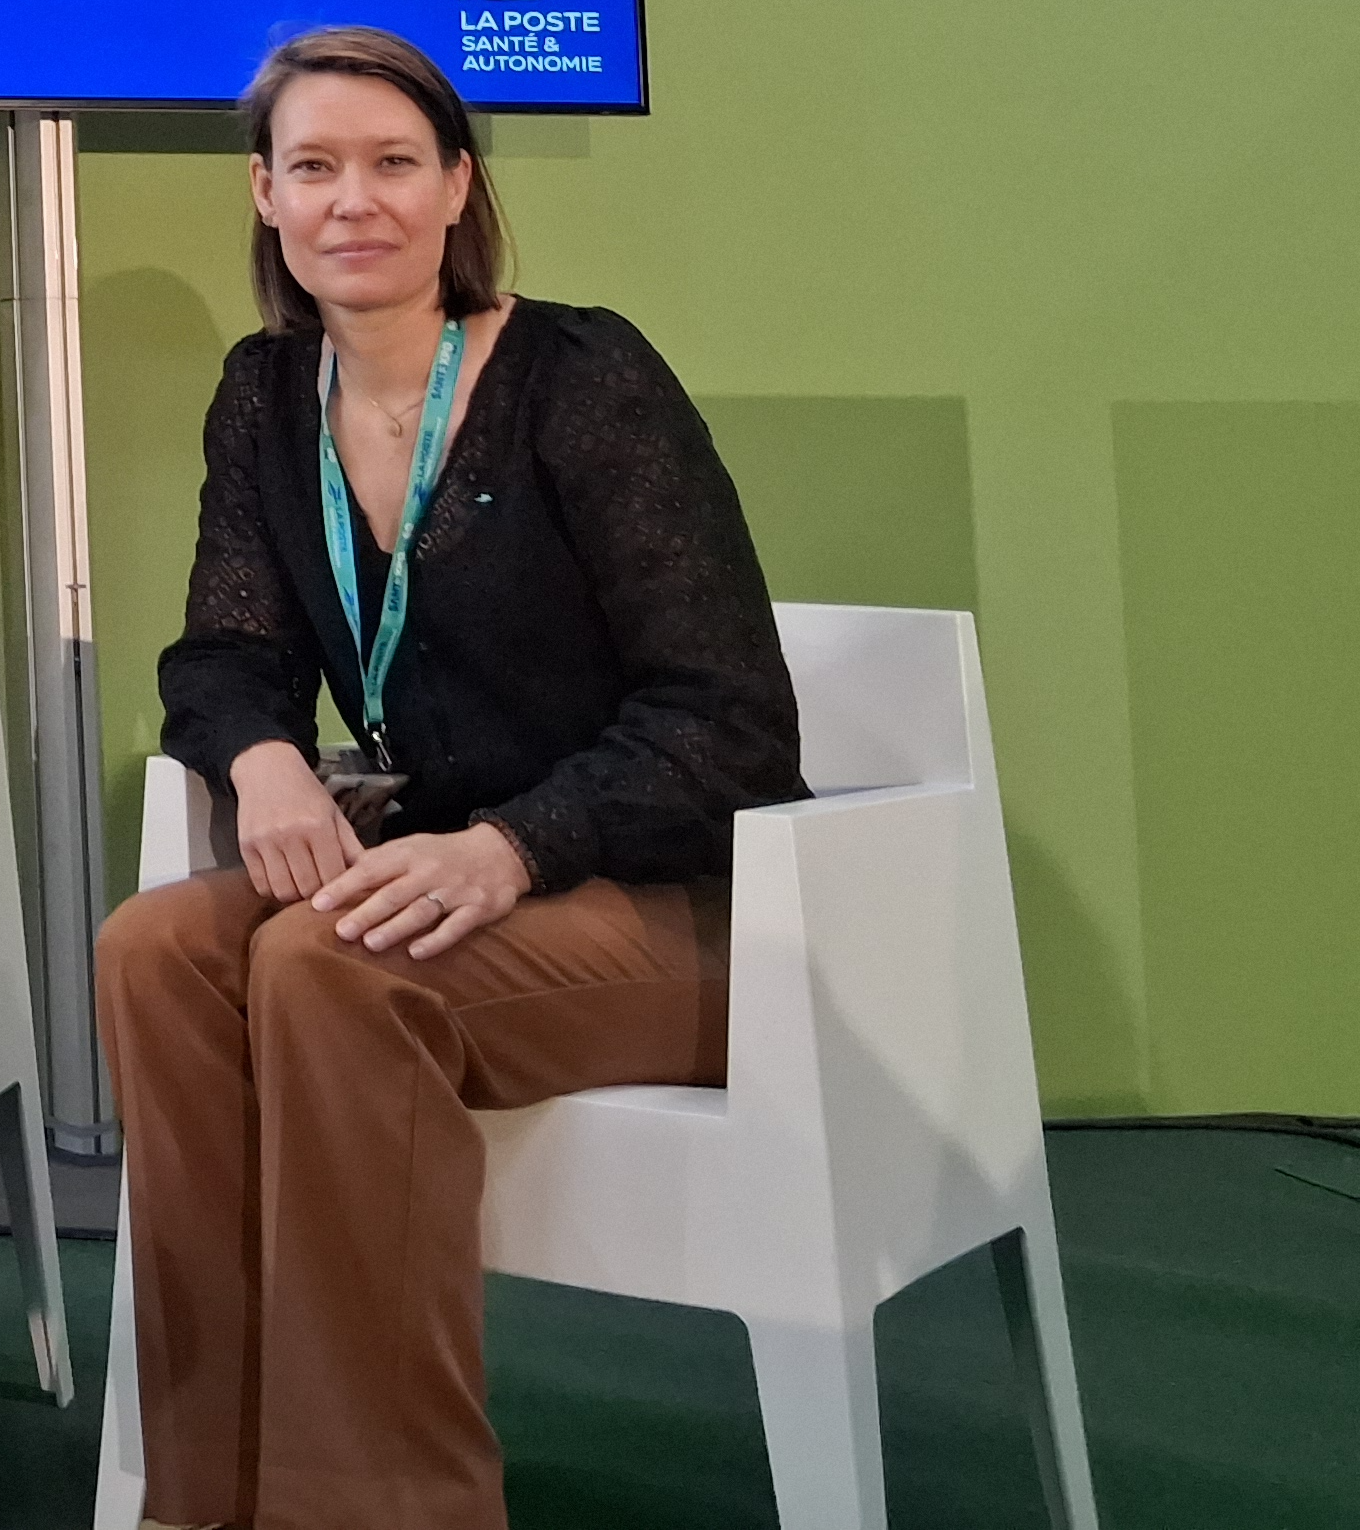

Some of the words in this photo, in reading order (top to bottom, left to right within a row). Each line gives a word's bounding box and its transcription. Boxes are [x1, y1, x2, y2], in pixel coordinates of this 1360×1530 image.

[460, 10, 499, 31] LA
[503, 11, 601, 32] POSTE
[461, 33, 539, 52] SANTÉ
[543, 36, 560, 53] &
[462, 54, 603, 73] AUTONOMIE
